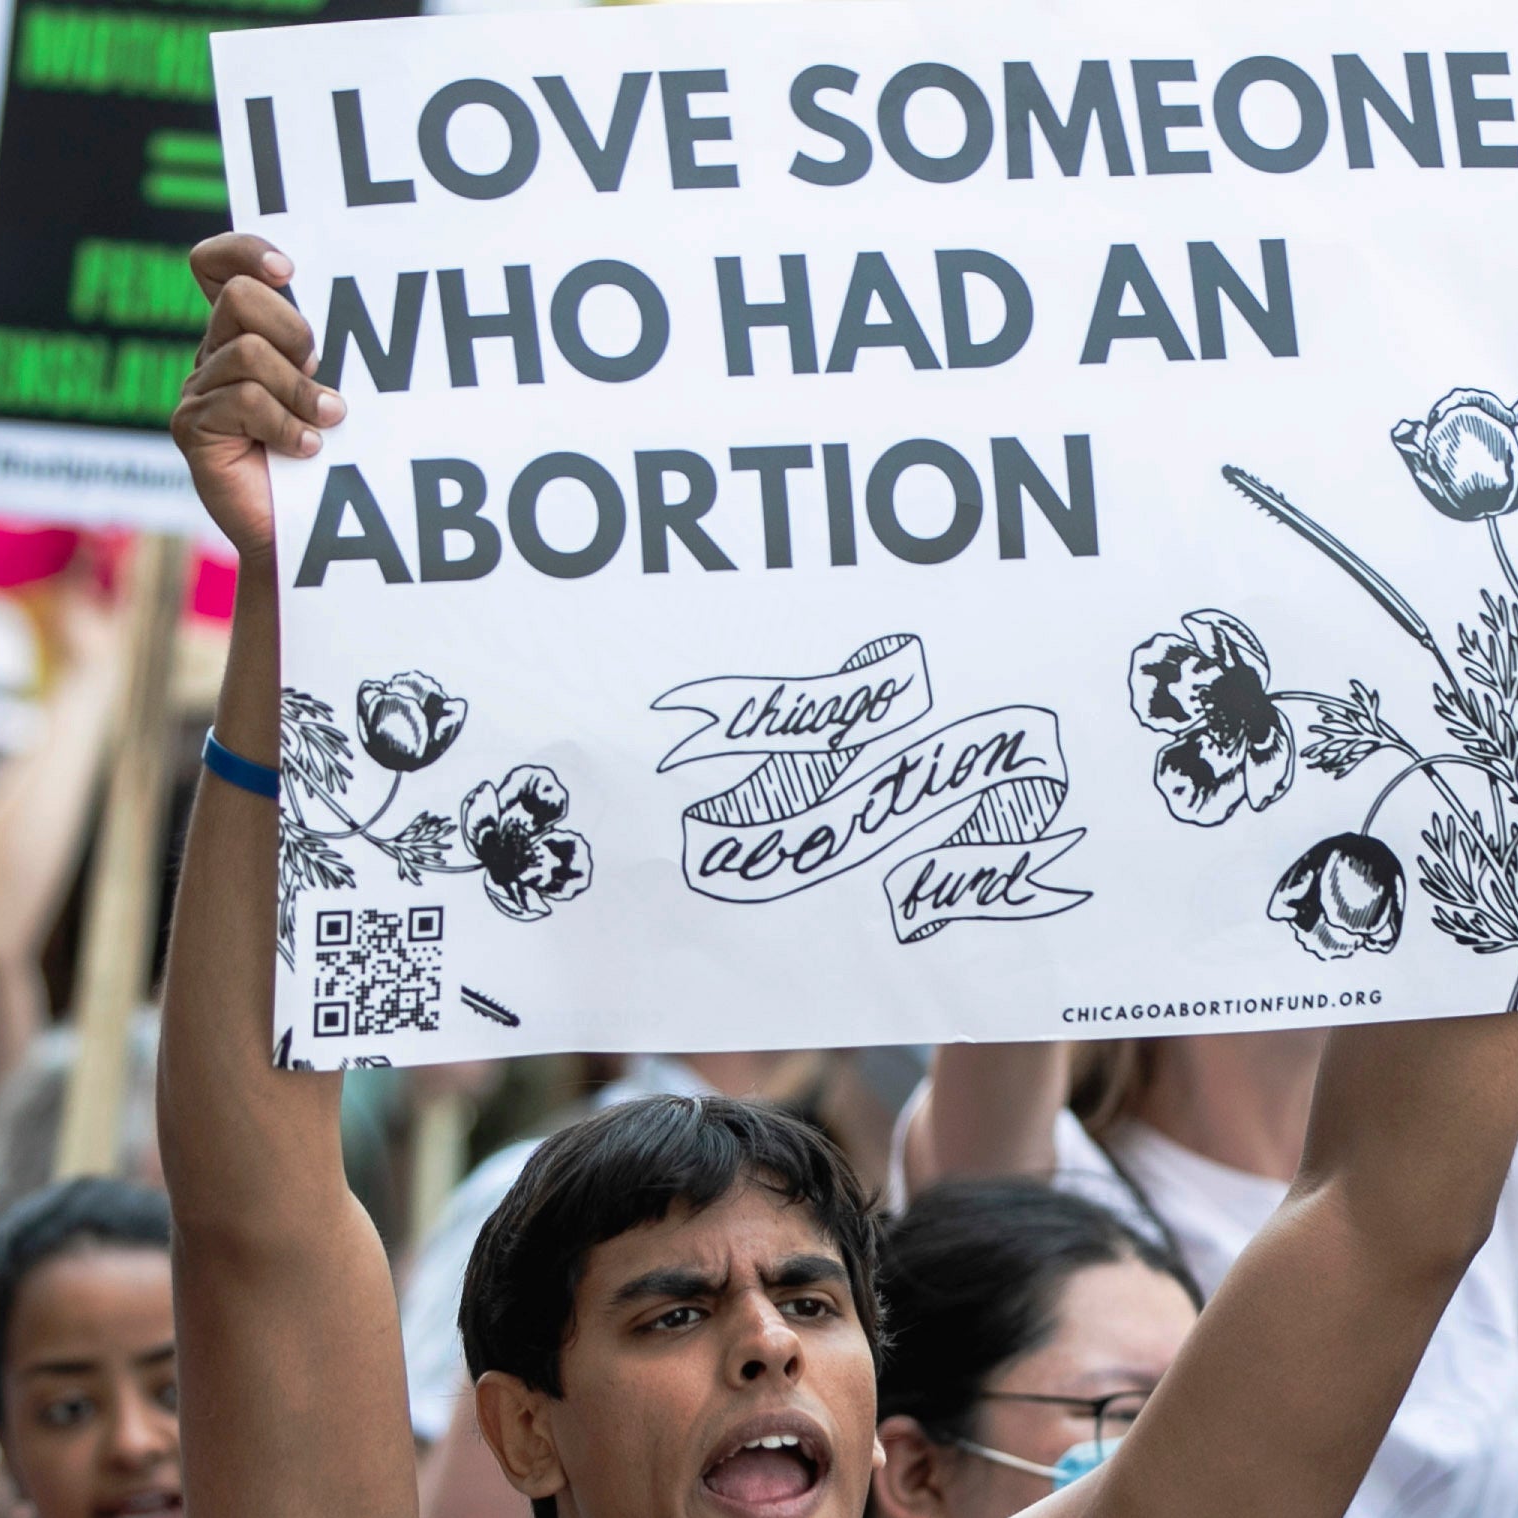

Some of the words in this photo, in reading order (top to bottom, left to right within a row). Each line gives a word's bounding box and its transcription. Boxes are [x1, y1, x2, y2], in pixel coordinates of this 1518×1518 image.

[244, 96, 287, 215] I
[331, 68, 740, 208] LOVE
[283, 258, 671, 394] WHO
[715, 246, 1034, 379] HAD
[1078, 238, 1300, 368] AN
[293, 434, 1101, 589] ABORTION
[724, 673, 915, 751] chicago
[698, 730, 1047, 881] abortion
[899, 851, 1036, 921] fund
[1061, 989, 1383, 1024] CHICAGOABORTIONFUND.ORG
